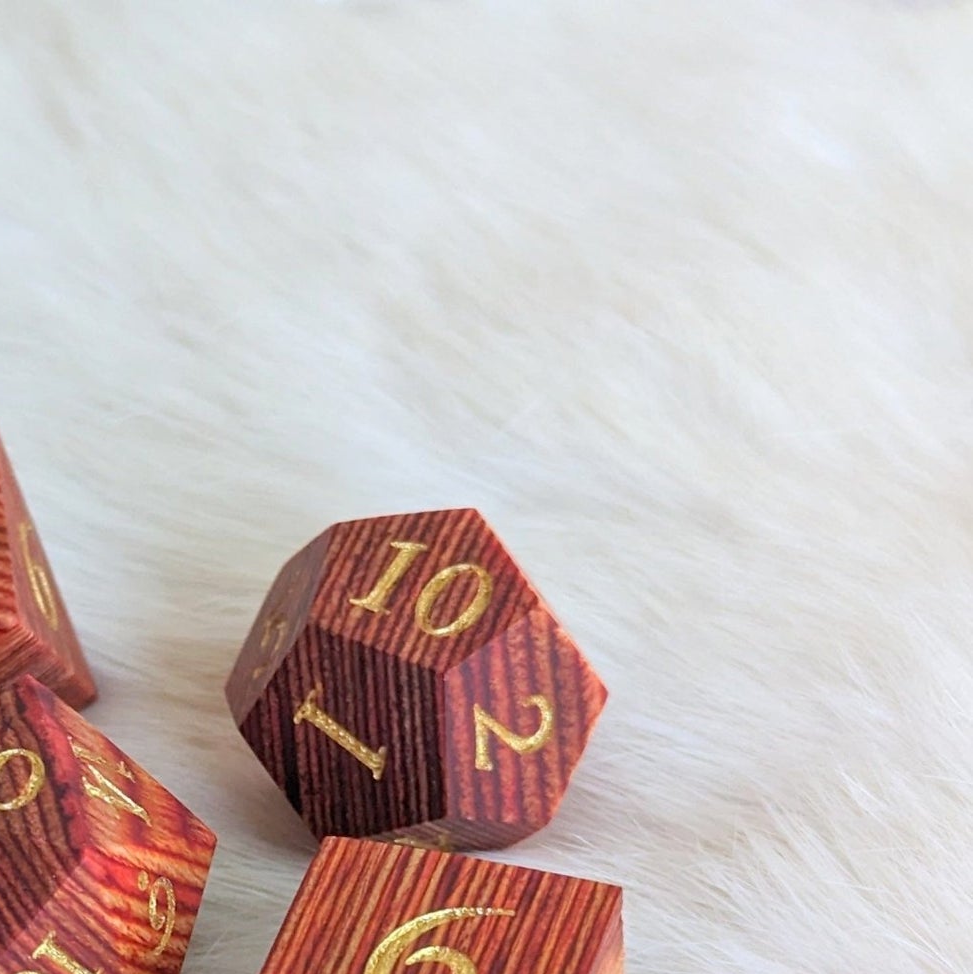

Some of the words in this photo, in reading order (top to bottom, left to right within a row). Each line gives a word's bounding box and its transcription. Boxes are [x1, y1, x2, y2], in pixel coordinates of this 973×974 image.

[349, 540, 493, 637] 10
[293, 681, 388, 781] 1
[472, 694, 555, 772] 2
